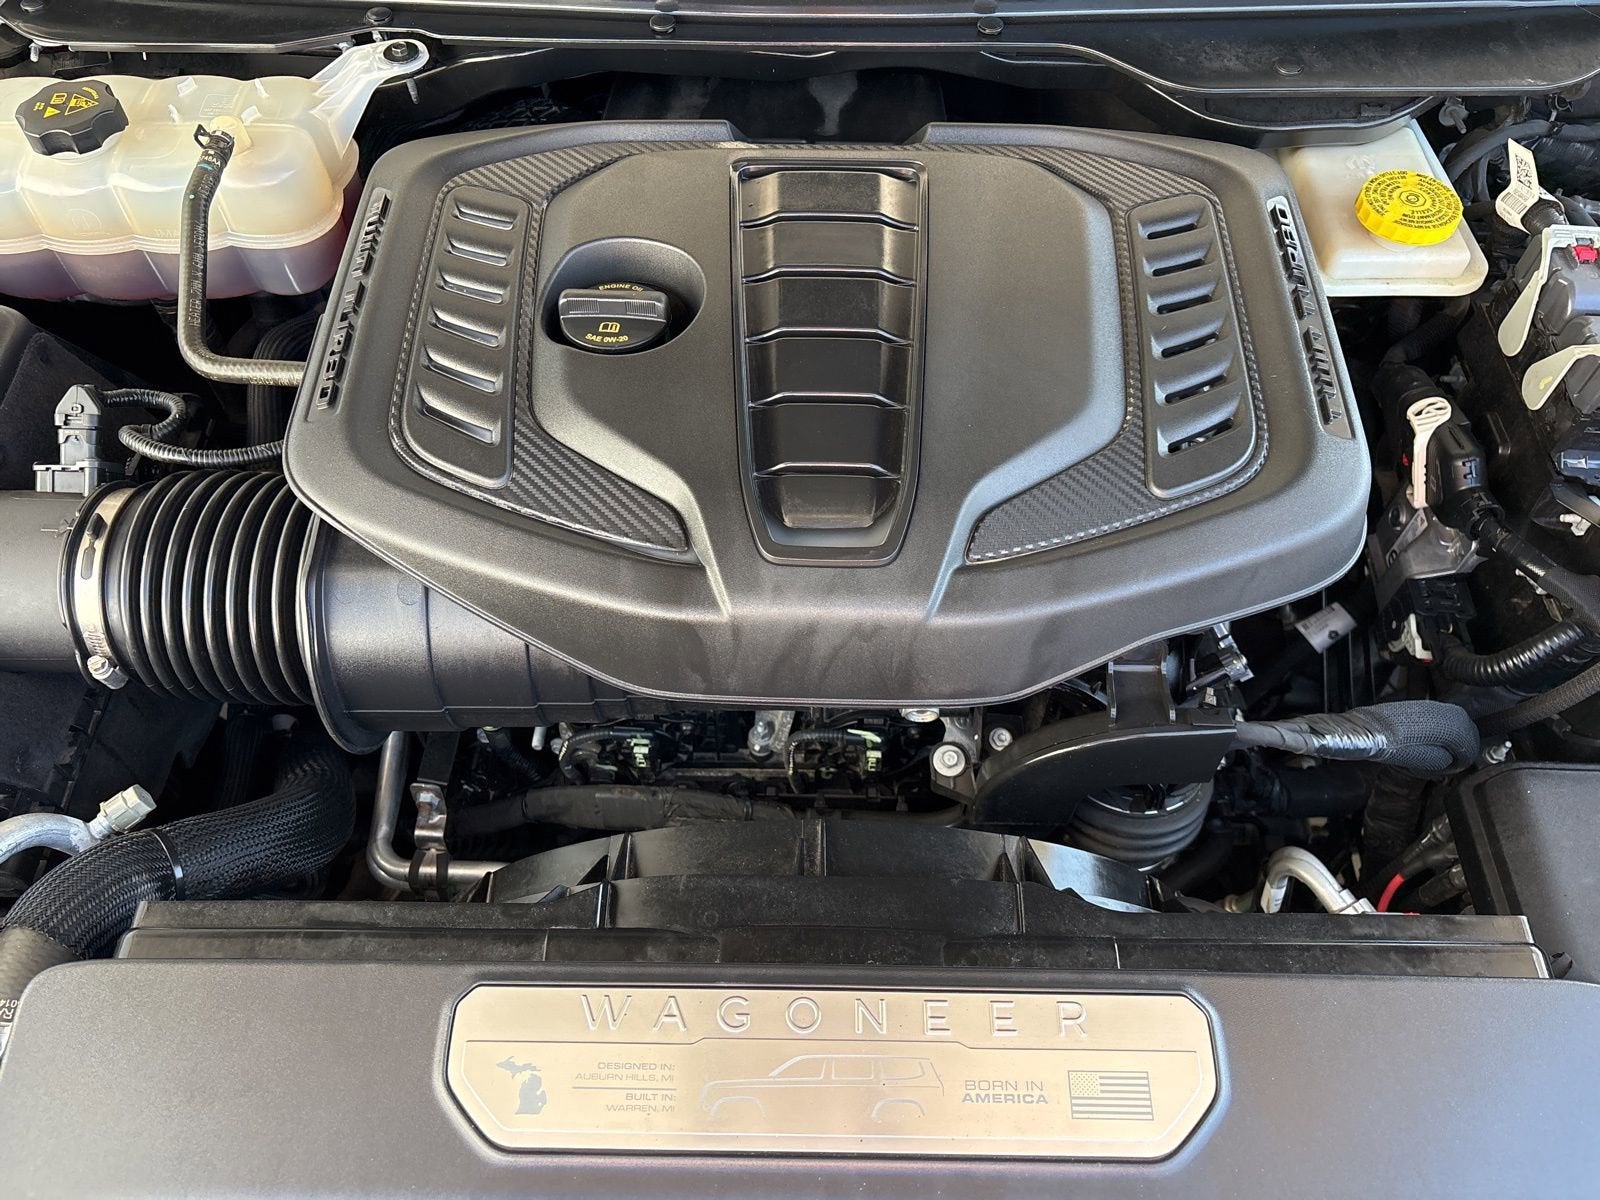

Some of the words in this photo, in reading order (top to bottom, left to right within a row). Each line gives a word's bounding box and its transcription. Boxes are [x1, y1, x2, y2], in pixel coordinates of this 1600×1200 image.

[598, 283, 631, 291] ENGINE
[585, 333, 603, 342] SAE
[603, 335, 629, 343] 0W-20
[316, 280, 366, 411] TURBO
[580, 993, 1089, 1038] WAGONEER
[597, 1061, 658, 1071] DESIGNED
[660, 1063, 676, 1071] IN:
[575, 1072, 624, 1081] AUBURN
[625, 1073, 659, 1083] HILLS,
[661, 1074, 675, 1083] MI
[964, 1079, 1018, 1092] BORN
[1026, 1080, 1044, 1092] IN
[625, 1092, 659, 1101] BUILT
[661, 1093, 677, 1102] IN:
[961, 1093, 1049, 1105] AMERICA
[606, 1104, 660, 1113] WARREN,
[662, 1104, 676, 1113] MI
